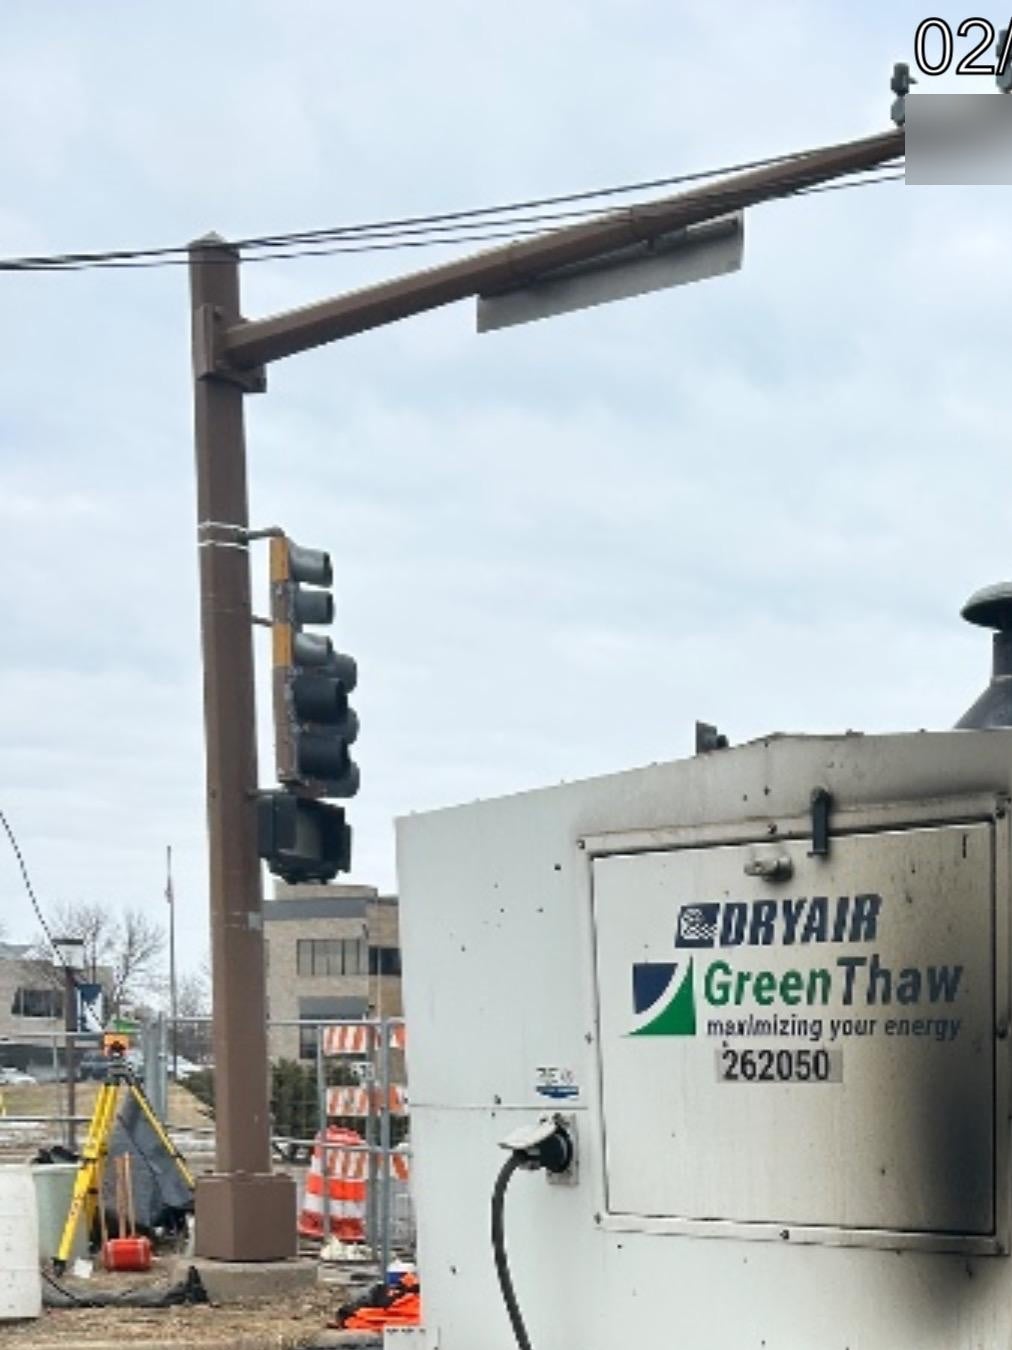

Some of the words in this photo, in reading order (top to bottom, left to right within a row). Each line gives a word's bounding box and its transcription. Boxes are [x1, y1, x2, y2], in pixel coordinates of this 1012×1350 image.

[719, 894, 883, 947] DRYAIR
[704, 953, 964, 1007] GreenThaw
[706, 1013, 824, 1042] maximizing
[829, 1018, 878, 1042] your
[884, 1016, 962, 1042] energy
[721, 1049, 830, 1082] 262050
